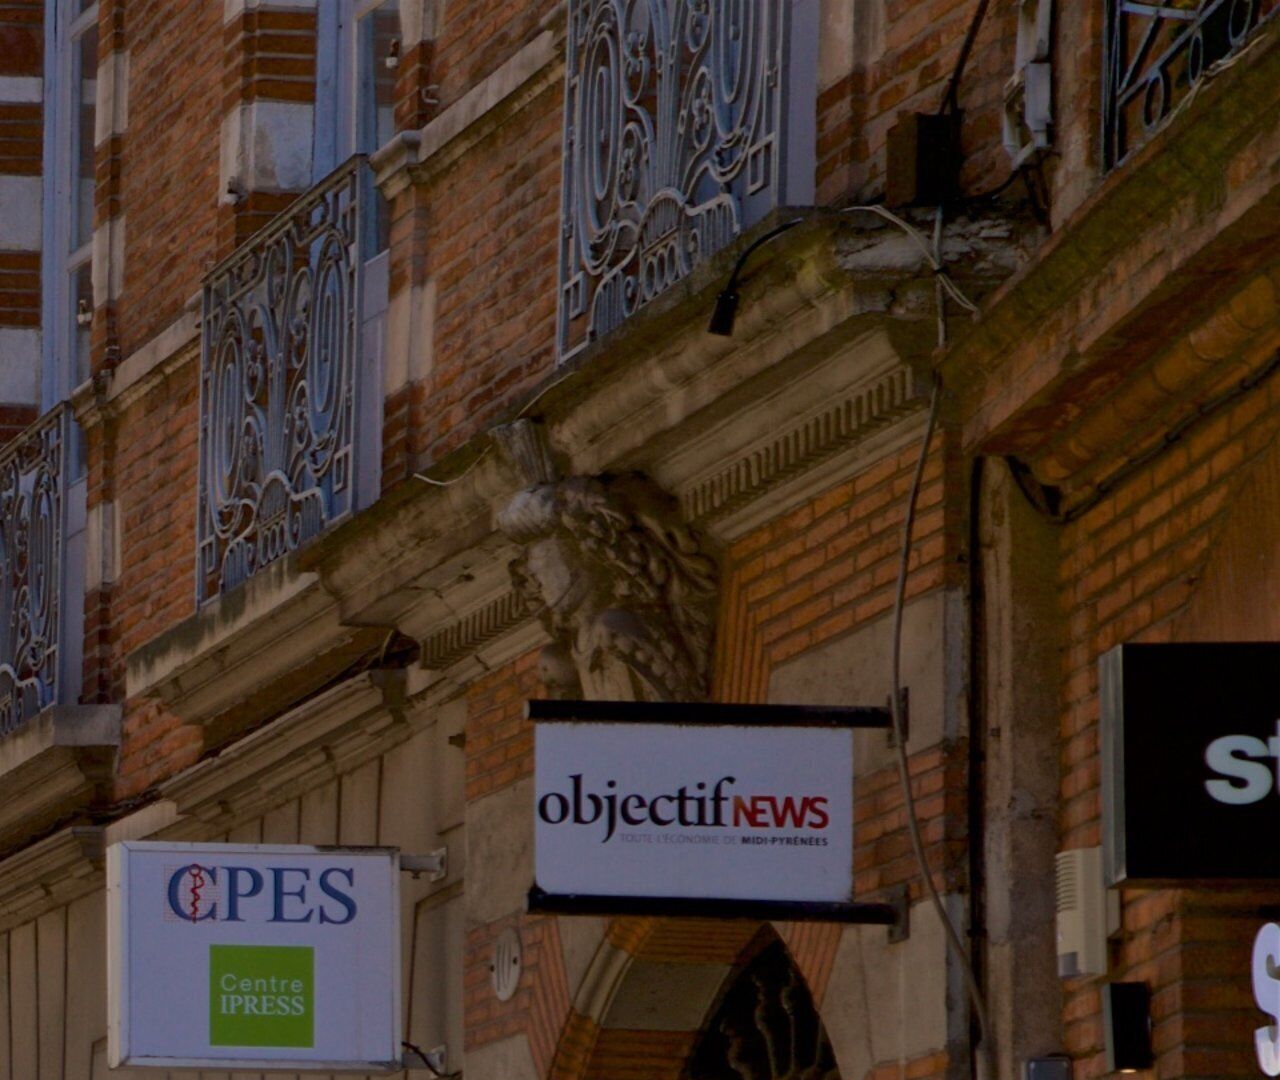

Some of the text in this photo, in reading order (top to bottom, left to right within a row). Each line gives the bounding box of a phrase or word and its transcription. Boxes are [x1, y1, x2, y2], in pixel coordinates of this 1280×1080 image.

[620, 831, 829, 846] TOUTE L'ÉCONOMIE DE MIDI-PYRÉNÉES
[167, 863, 358, 925] CPES
[220, 973, 304, 993] Centre
[220, 994, 305, 1016] IPRESS
